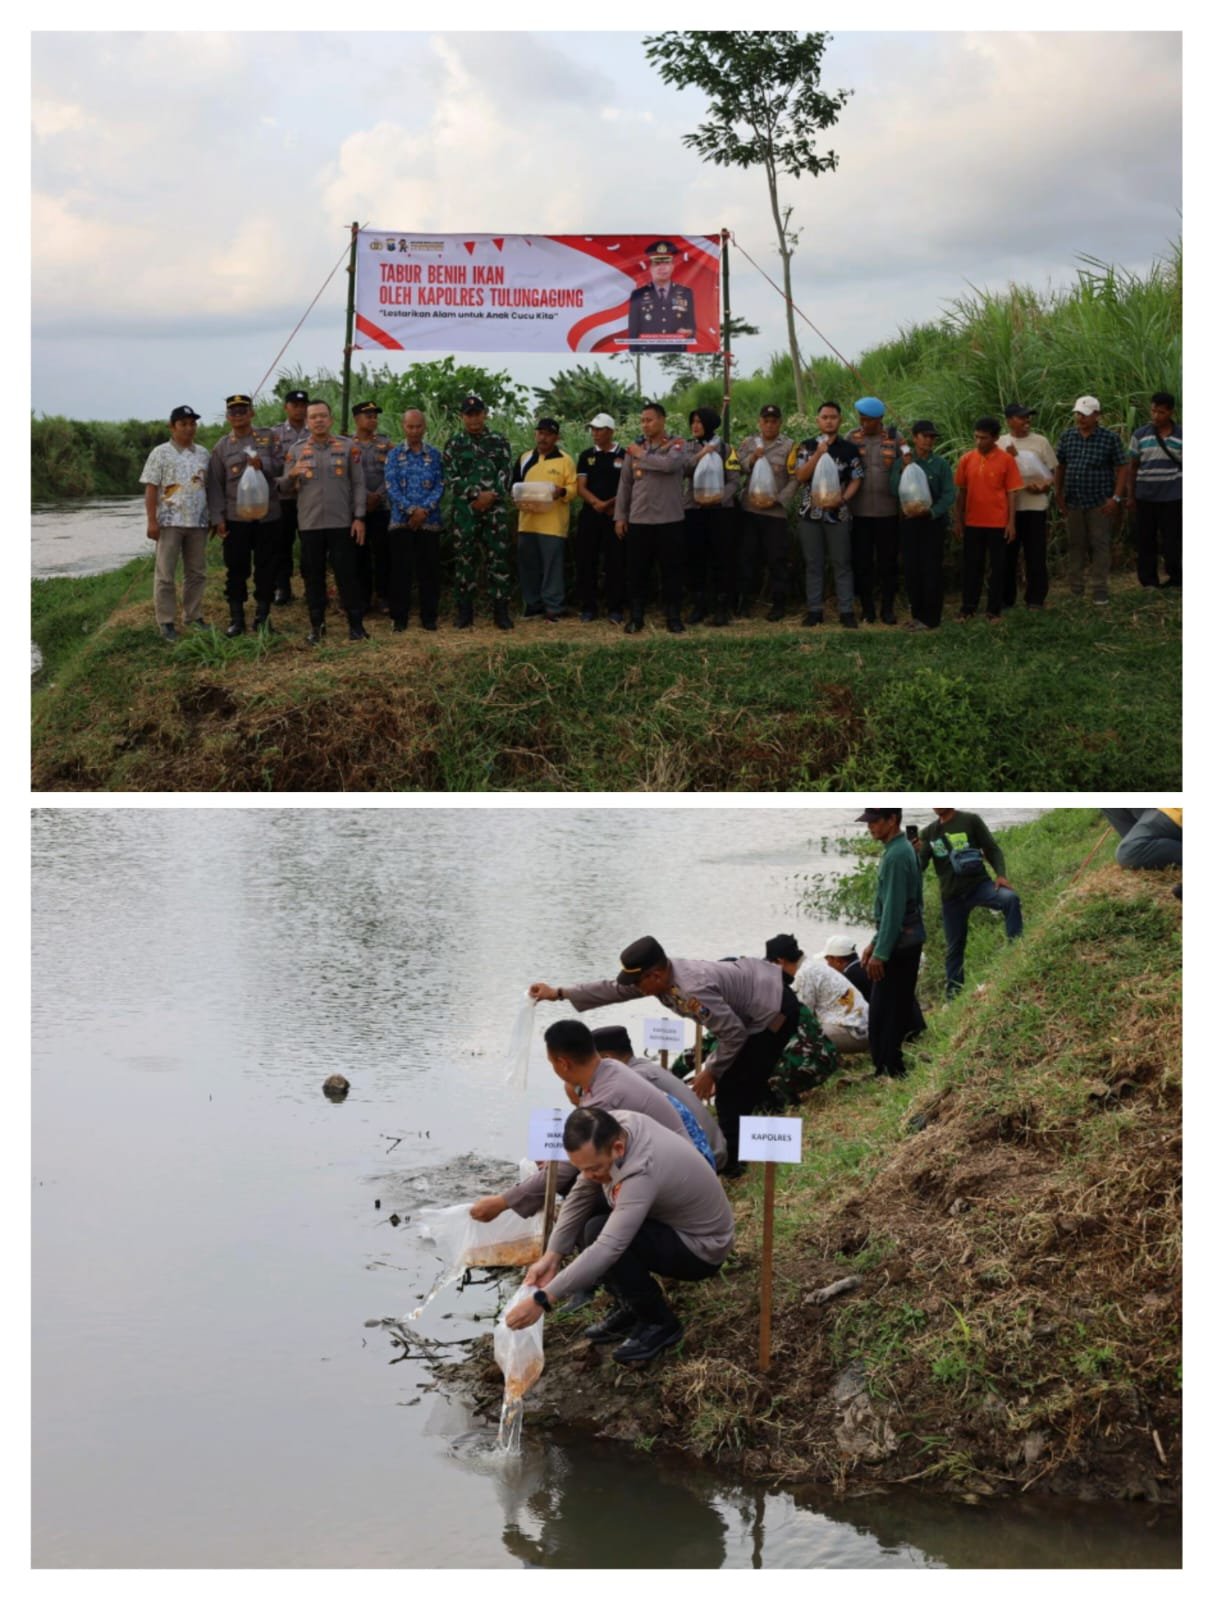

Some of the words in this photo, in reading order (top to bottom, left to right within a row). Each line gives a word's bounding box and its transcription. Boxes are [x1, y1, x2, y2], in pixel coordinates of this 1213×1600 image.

[379, 263, 421, 284] TABUR
[428, 264, 467, 285] BENIH
[473, 265, 505, 285] IKAN
[379, 285, 412, 305] OLEH
[418, 286, 484, 307] KAPOLRES
[491, 288, 584, 308] TULUNGAGUNG
[432, 310, 457, 318] Alam
[458, 311, 485, 319] untuk
[486, 311, 509, 320] Anak
[511, 312, 535, 320] Cucu
[751, 1132, 793, 1142] KAPOLRES
